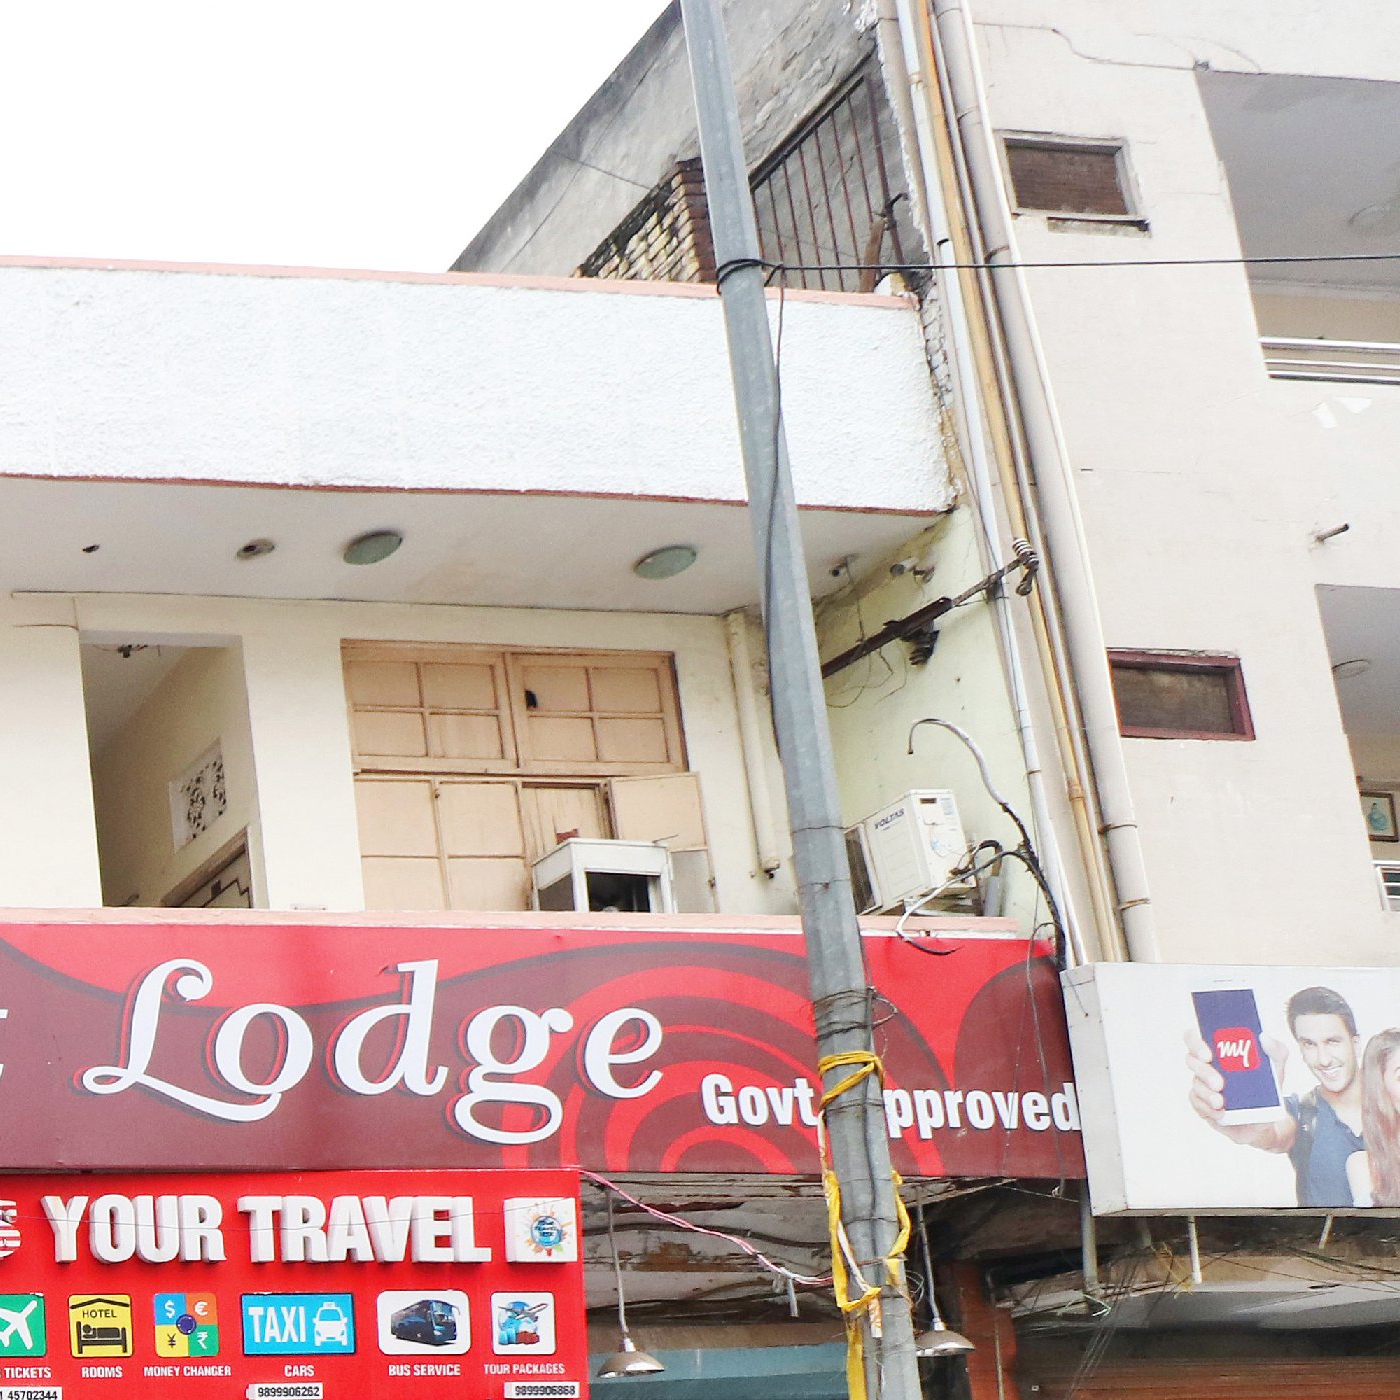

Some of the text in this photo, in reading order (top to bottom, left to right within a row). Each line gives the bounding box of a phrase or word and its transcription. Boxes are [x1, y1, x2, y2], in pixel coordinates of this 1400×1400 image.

[82, 957, 663, 1146] Lodge
[1216, 1038, 1252, 1068] my
[882, 1082, 1082, 1140] pproved
[40, 1194, 492, 1263] YOUR TRAVEL
[82, 1309, 118, 1319] HOTEL
[248, 1305, 306, 1343] TAXI
[4, 1367, 52, 1379] TICKETS
[81, 1366, 123, 1379] ROOMS
[143, 1365, 232, 1378] MONEY CHANGER
[284, 1365, 315, 1377] CARS
[388, 1364, 461, 1377] BUS SERVICE
[483, 1363, 566, 1375] TOUR PACKAGES
[257, 1386, 321, 1398] 9899906262
